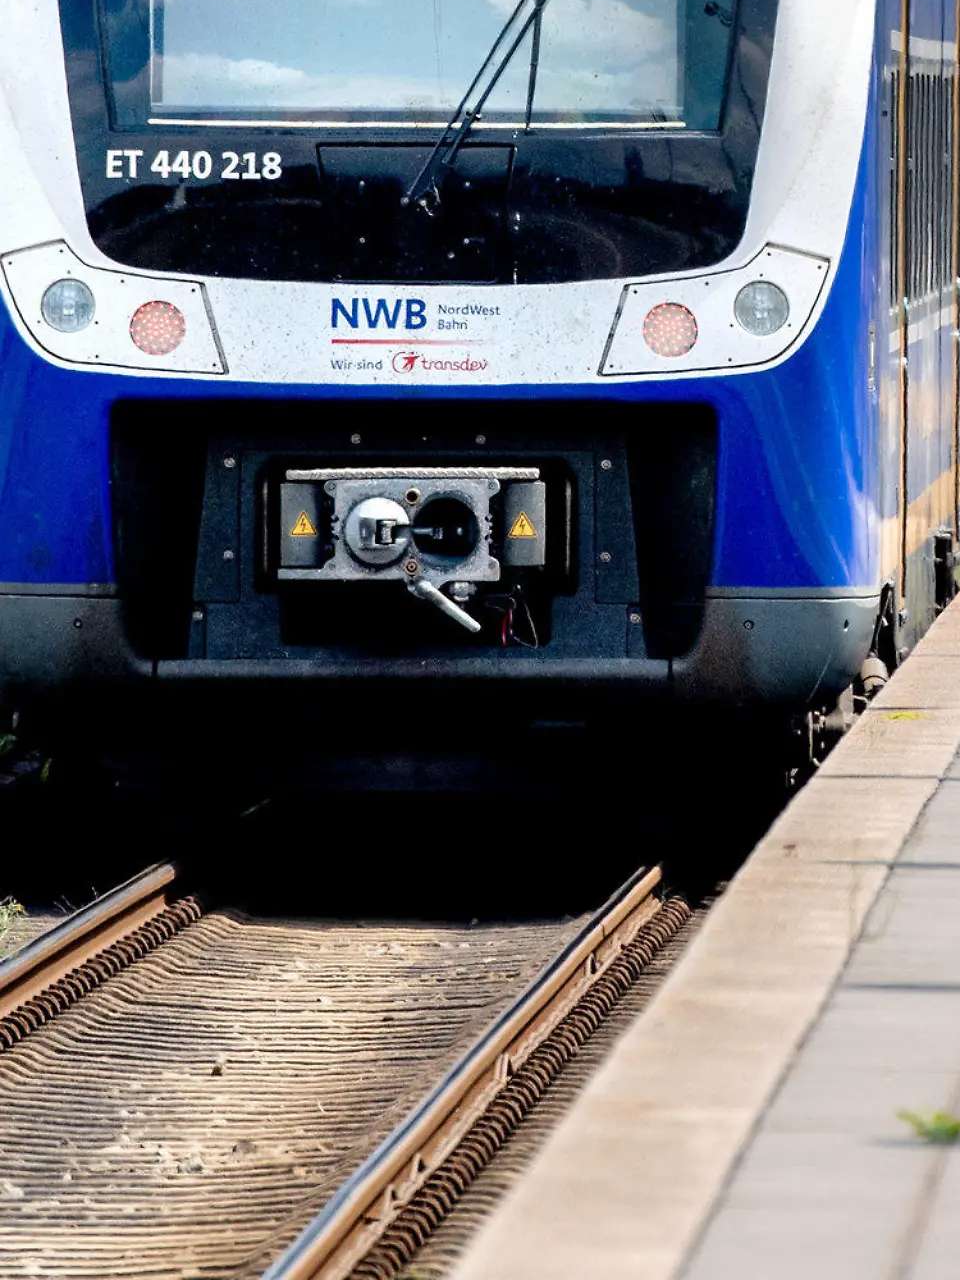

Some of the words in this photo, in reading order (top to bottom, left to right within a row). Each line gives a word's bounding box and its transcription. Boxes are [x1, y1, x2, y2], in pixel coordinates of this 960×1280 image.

[106, 150, 143, 178] ET
[150, 150, 213, 179] 440
[221, 151, 283, 180] 218
[331, 297, 427, 330] NWB
[437, 304, 501, 316] NordWest
[437, 319, 468, 330] Bahn
[330, 359, 353, 370] Wir
[356, 358, 383, 370] sind
[420, 357, 488, 371] transdev
